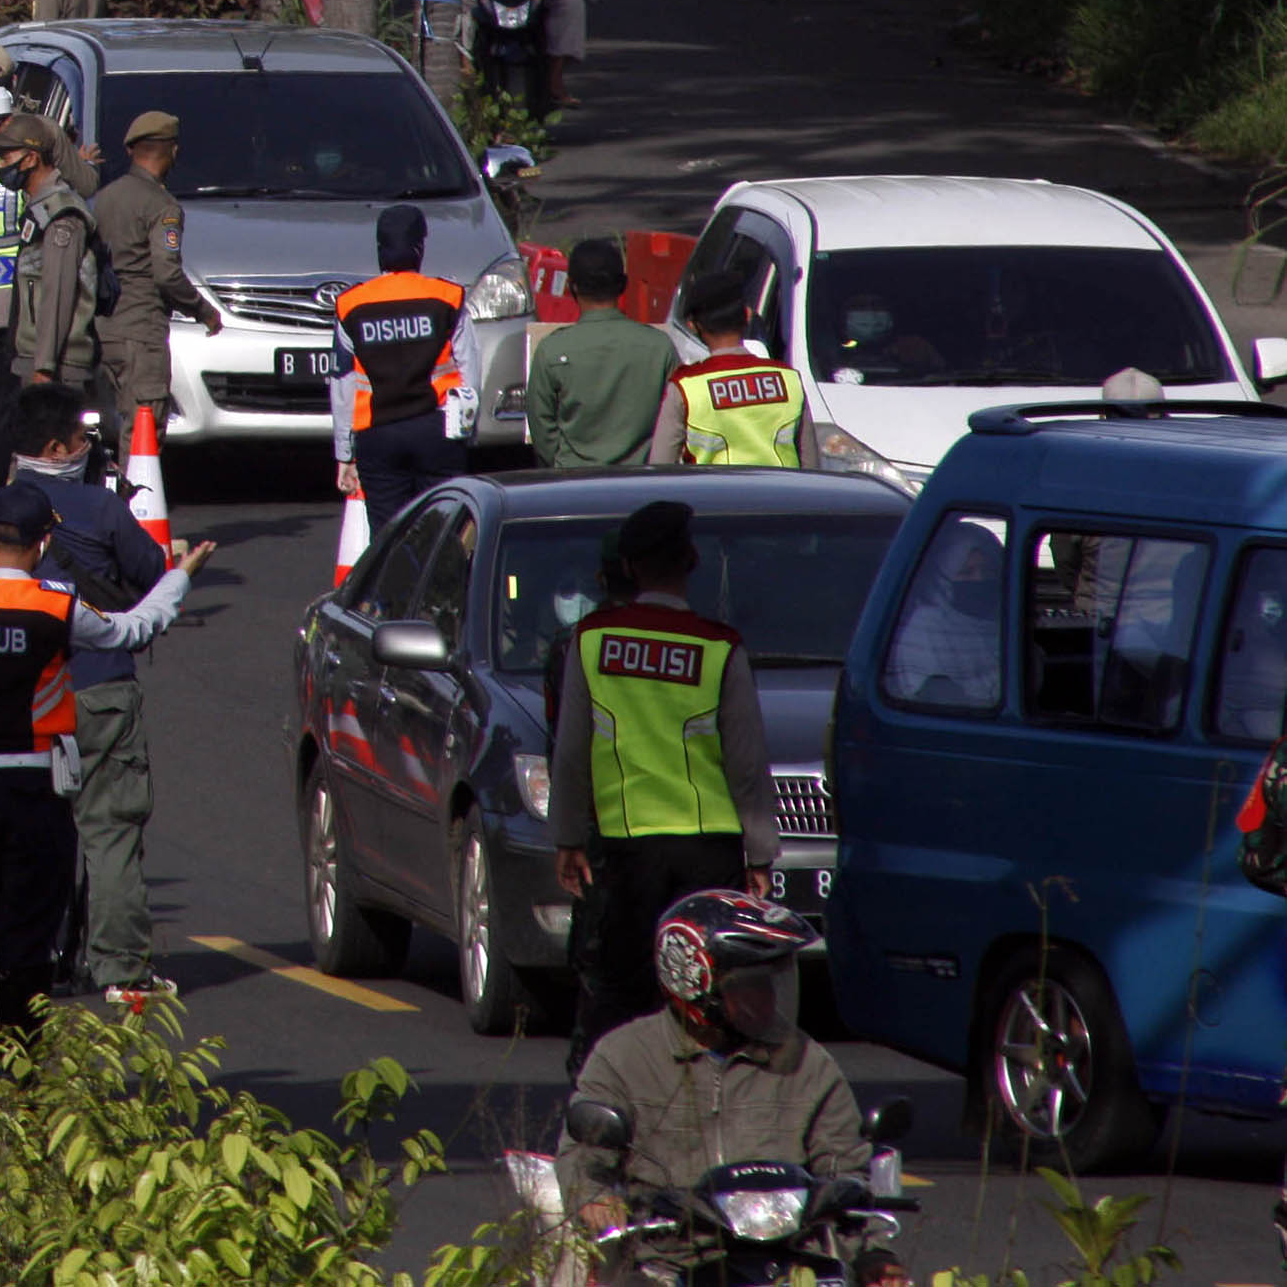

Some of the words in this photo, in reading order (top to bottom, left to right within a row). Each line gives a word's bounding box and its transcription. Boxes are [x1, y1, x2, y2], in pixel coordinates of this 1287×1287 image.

[361, 316, 432, 342] DISHUB
[283, 353, 295, 375] B
[711, 375, 784, 405] POLISI
[603, 640, 696, 679] POLISI
